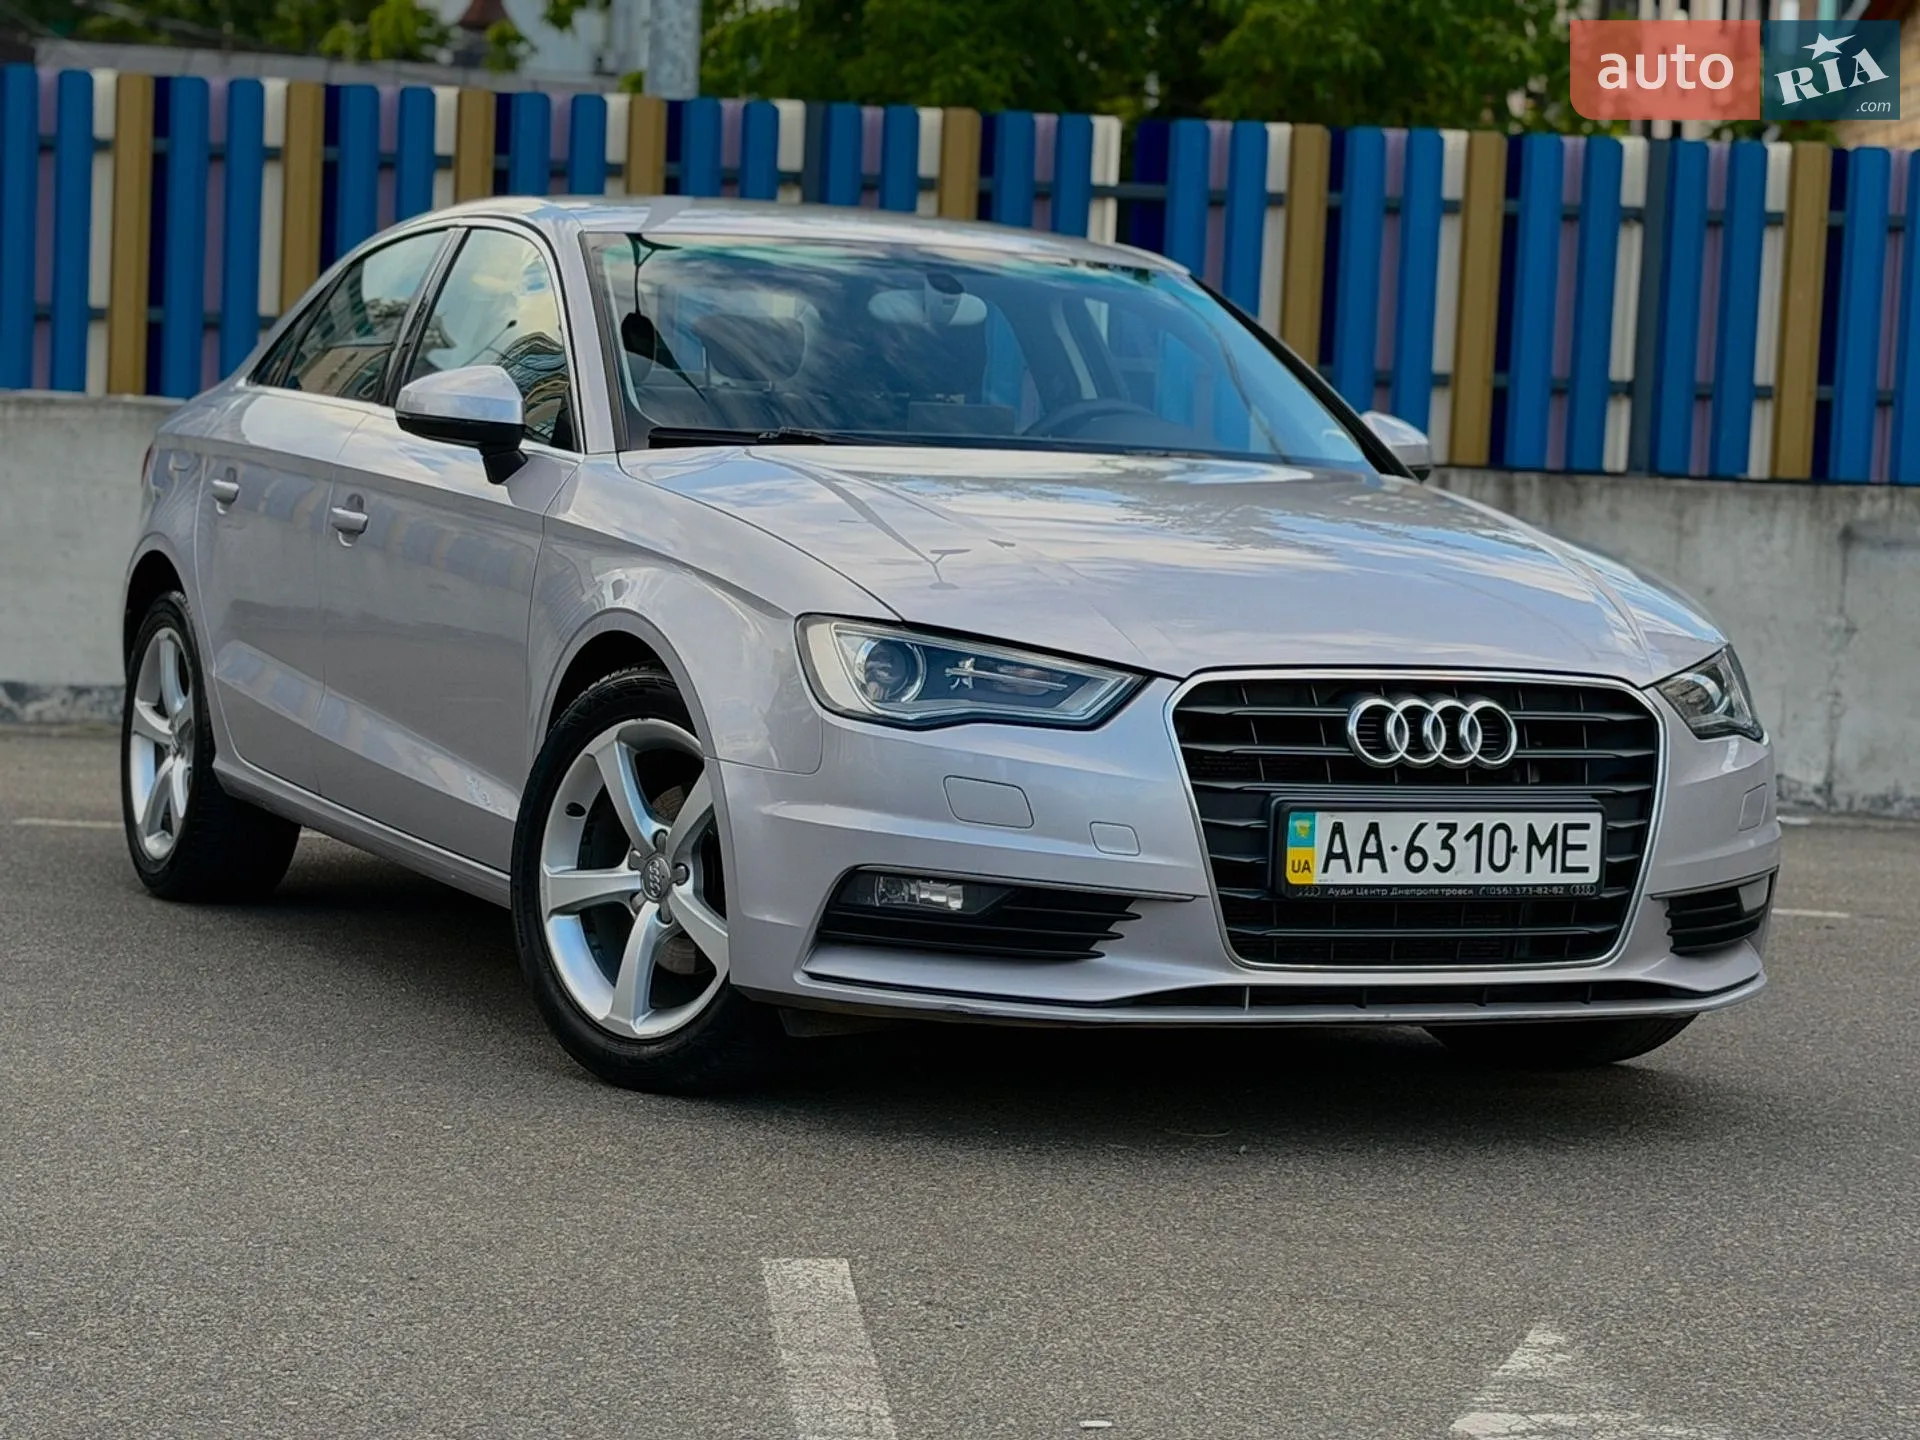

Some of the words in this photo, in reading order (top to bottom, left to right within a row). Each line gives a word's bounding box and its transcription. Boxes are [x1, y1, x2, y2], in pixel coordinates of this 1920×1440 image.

[1291, 860, 1312, 873] UA
[1328, 887, 1353, 897] Ауди
[1356, 886, 1387, 896] Центр
